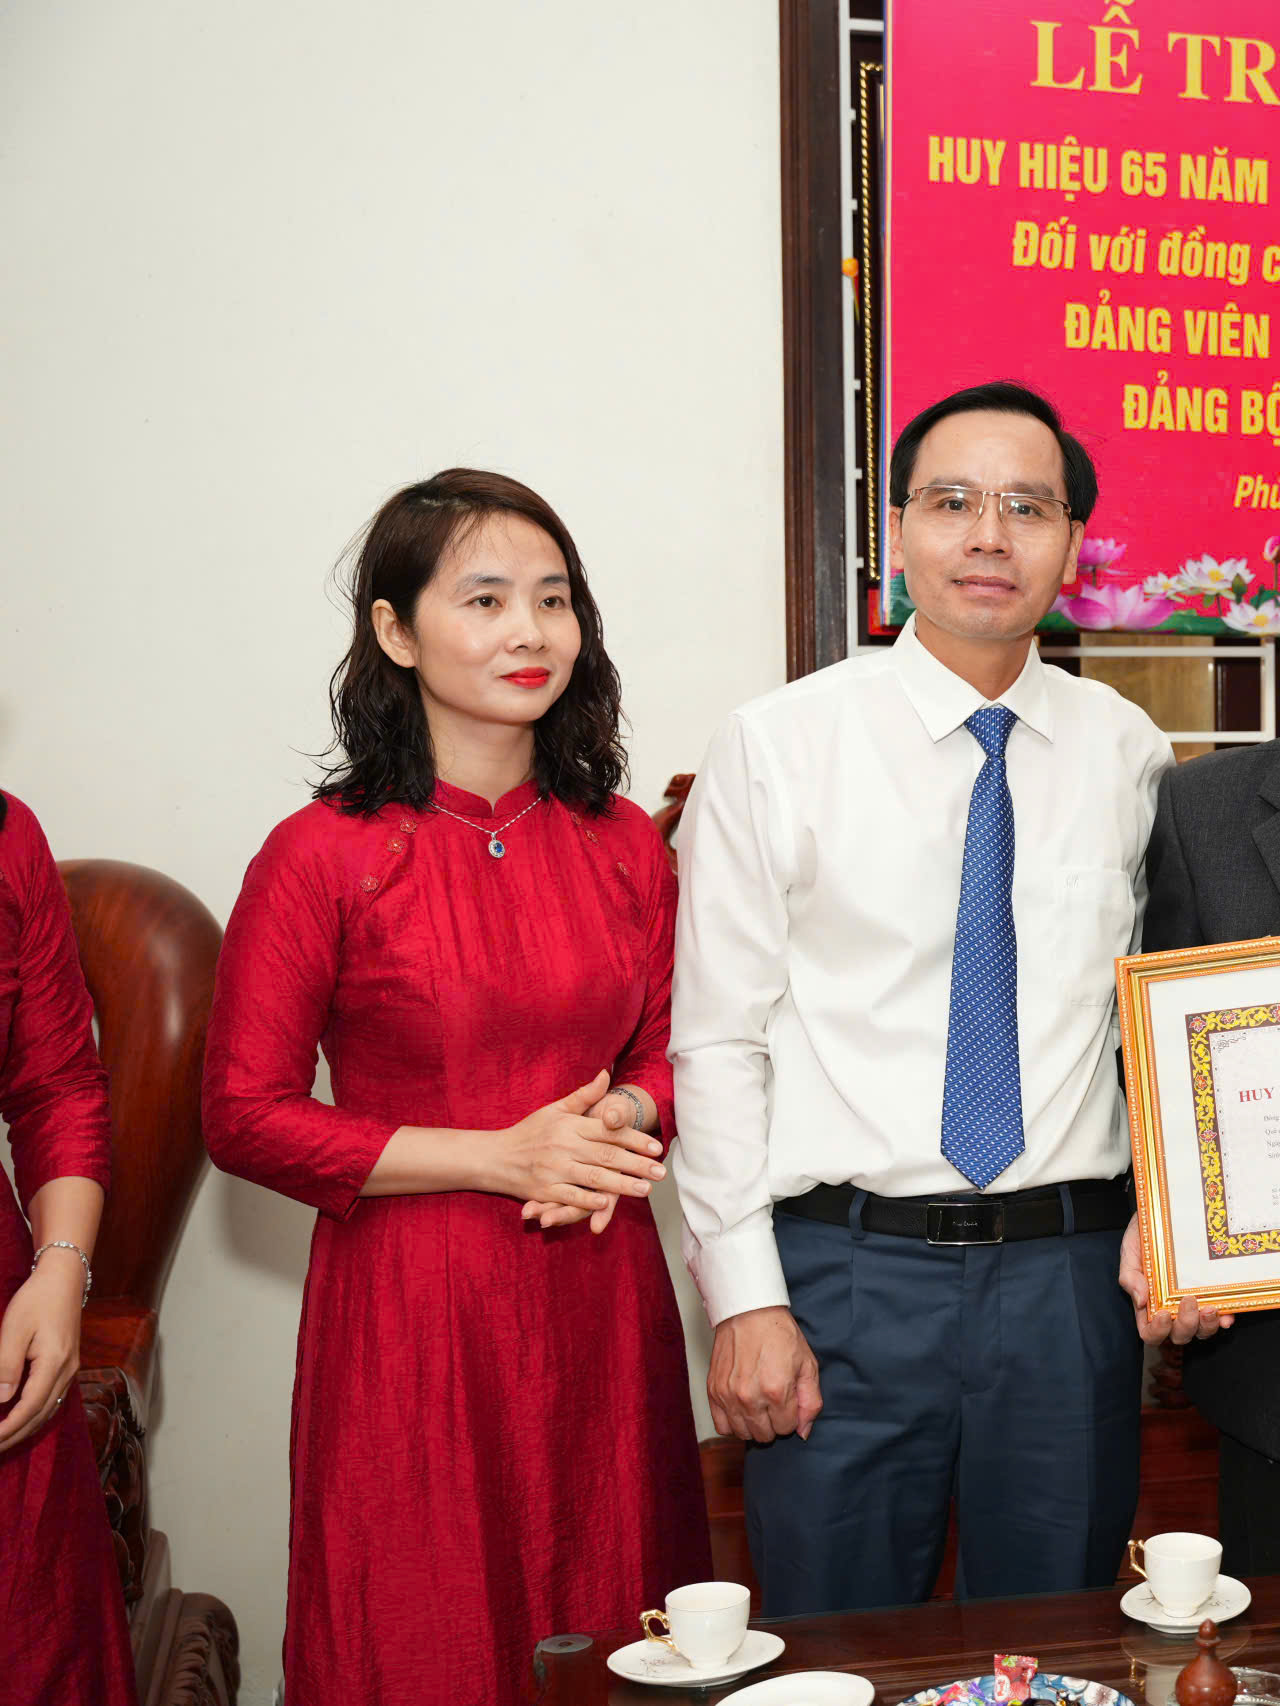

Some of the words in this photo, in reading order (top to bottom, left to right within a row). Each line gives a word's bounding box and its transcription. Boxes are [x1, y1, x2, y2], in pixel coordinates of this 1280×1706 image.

[1030, 0, 1144, 95] LỄ
[928, 135, 1007, 186] HUY
[1019, 135, 1109, 201] HIỆU
[1121, 149, 1168, 198] 65
[1180, 147, 1269, 205] NĂM
[1012, 214, 1077, 270] Đối
[1089, 226, 1147, 274] với
[1158, 225, 1252, 287] đồng
[1063, 289, 1173, 353] ĐẢNG
[1183, 302, 1270, 359] VIÊN
[1122, 370, 1229, 434] ĐẢNG
[1238, 1086, 1275, 1103] HUY
